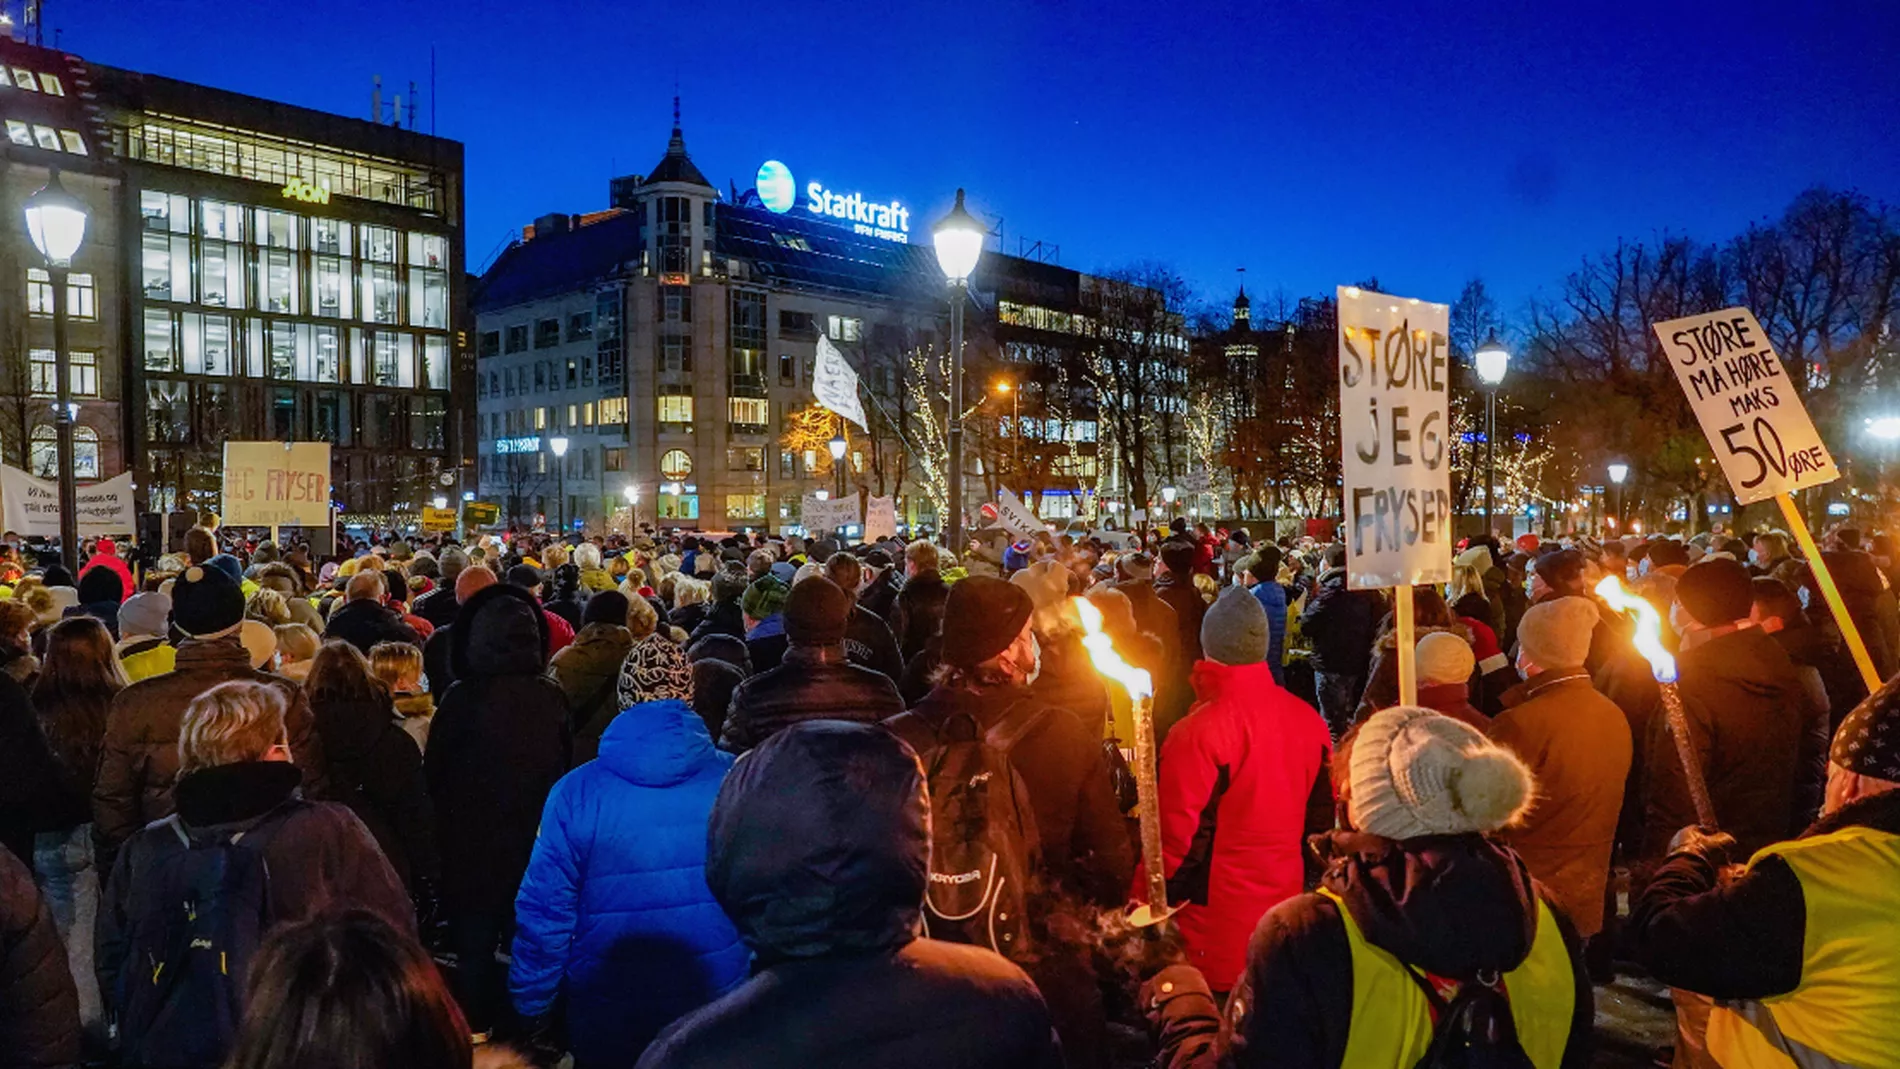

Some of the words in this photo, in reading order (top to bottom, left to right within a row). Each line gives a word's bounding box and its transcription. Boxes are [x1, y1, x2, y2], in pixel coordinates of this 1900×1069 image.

[807, 182, 909, 232] Statkraft
[1343, 318, 1447, 392] STØRE
[1672, 317, 1756, 366] STØRE
[1724, 349, 1780, 389] HØRE
[1729, 386, 1780, 418] MAKS
[1719, 416, 1788, 489] 50
[1787, 446, 1826, 482] ØRE
[265, 469, 325, 503] FRYSER
